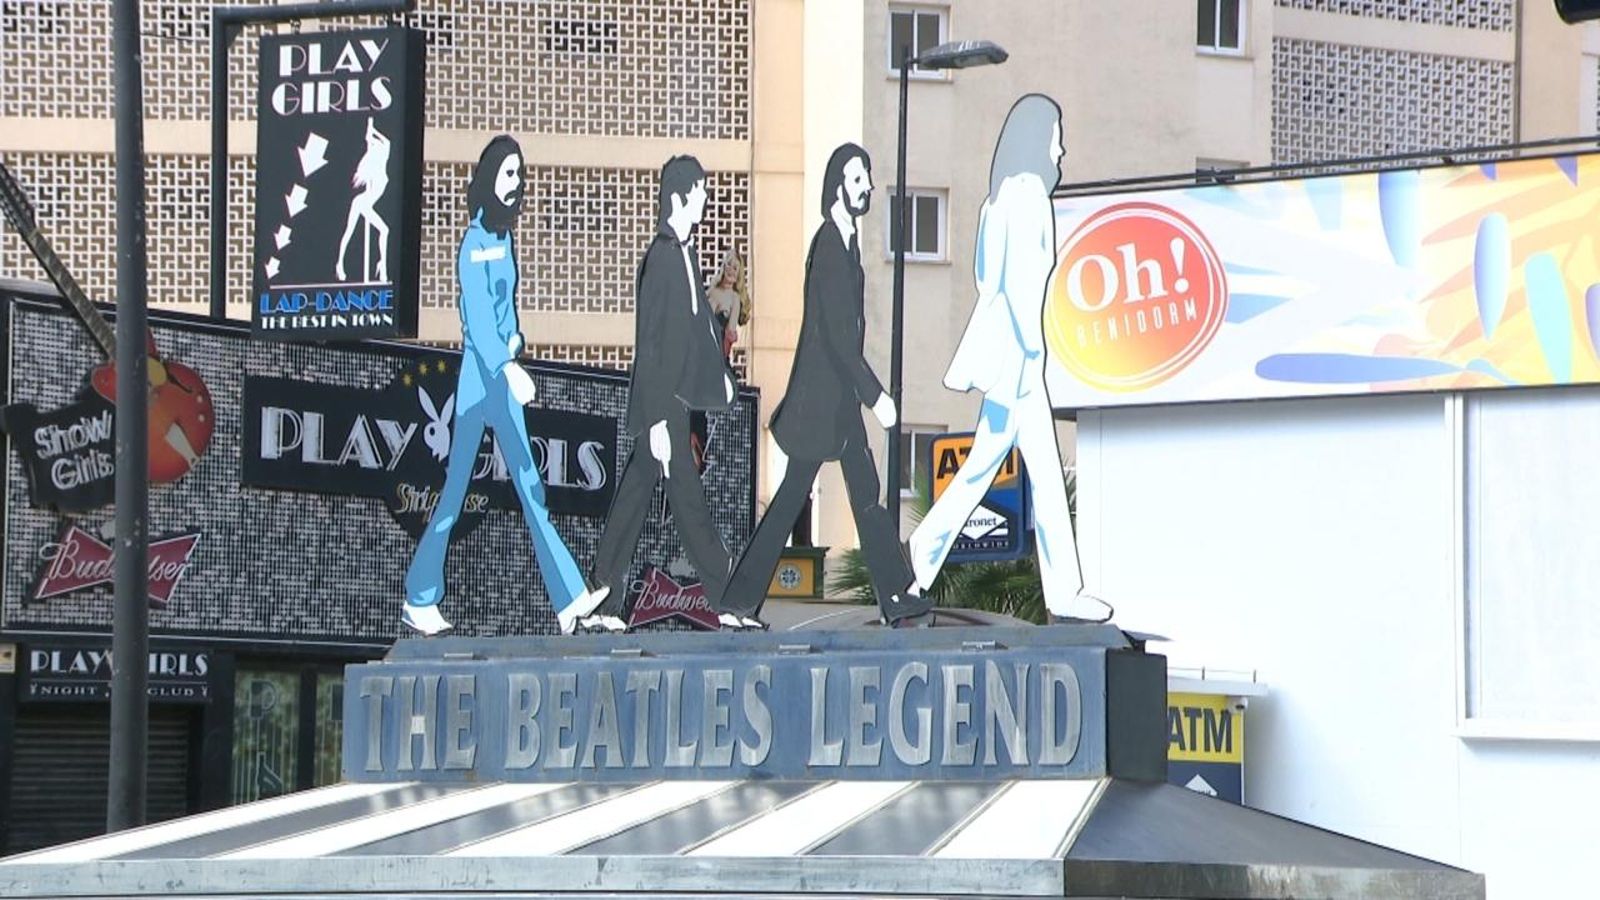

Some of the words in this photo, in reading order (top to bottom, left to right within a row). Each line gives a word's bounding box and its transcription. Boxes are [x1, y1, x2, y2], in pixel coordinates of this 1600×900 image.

[279, 38, 389, 77] PLAY
[271, 77, 393, 116] GIRLS
[1066, 236, 1190, 313] Oh!
[260, 289, 393, 314] LAP-DANCE
[261, 315, 287, 329] THE
[291, 314, 327, 329] BEST
[331, 313, 347, 328] IN
[350, 312, 393, 327] TOWN
[1075, 297, 1198, 348] BENIDORM
[260, 406, 418, 472] PLAY
[51, 448, 115, 491] Girls
[30, 649, 108, 675] PLAY
[148, 653, 209, 677] IRLS
[41, 685, 99, 697] NIGHT
[359, 674, 479, 773] THE
[503, 664, 774, 772] BEATLES
[806, 659, 1083, 768] LEGEND
[1166, 705, 1233, 754] ATM
